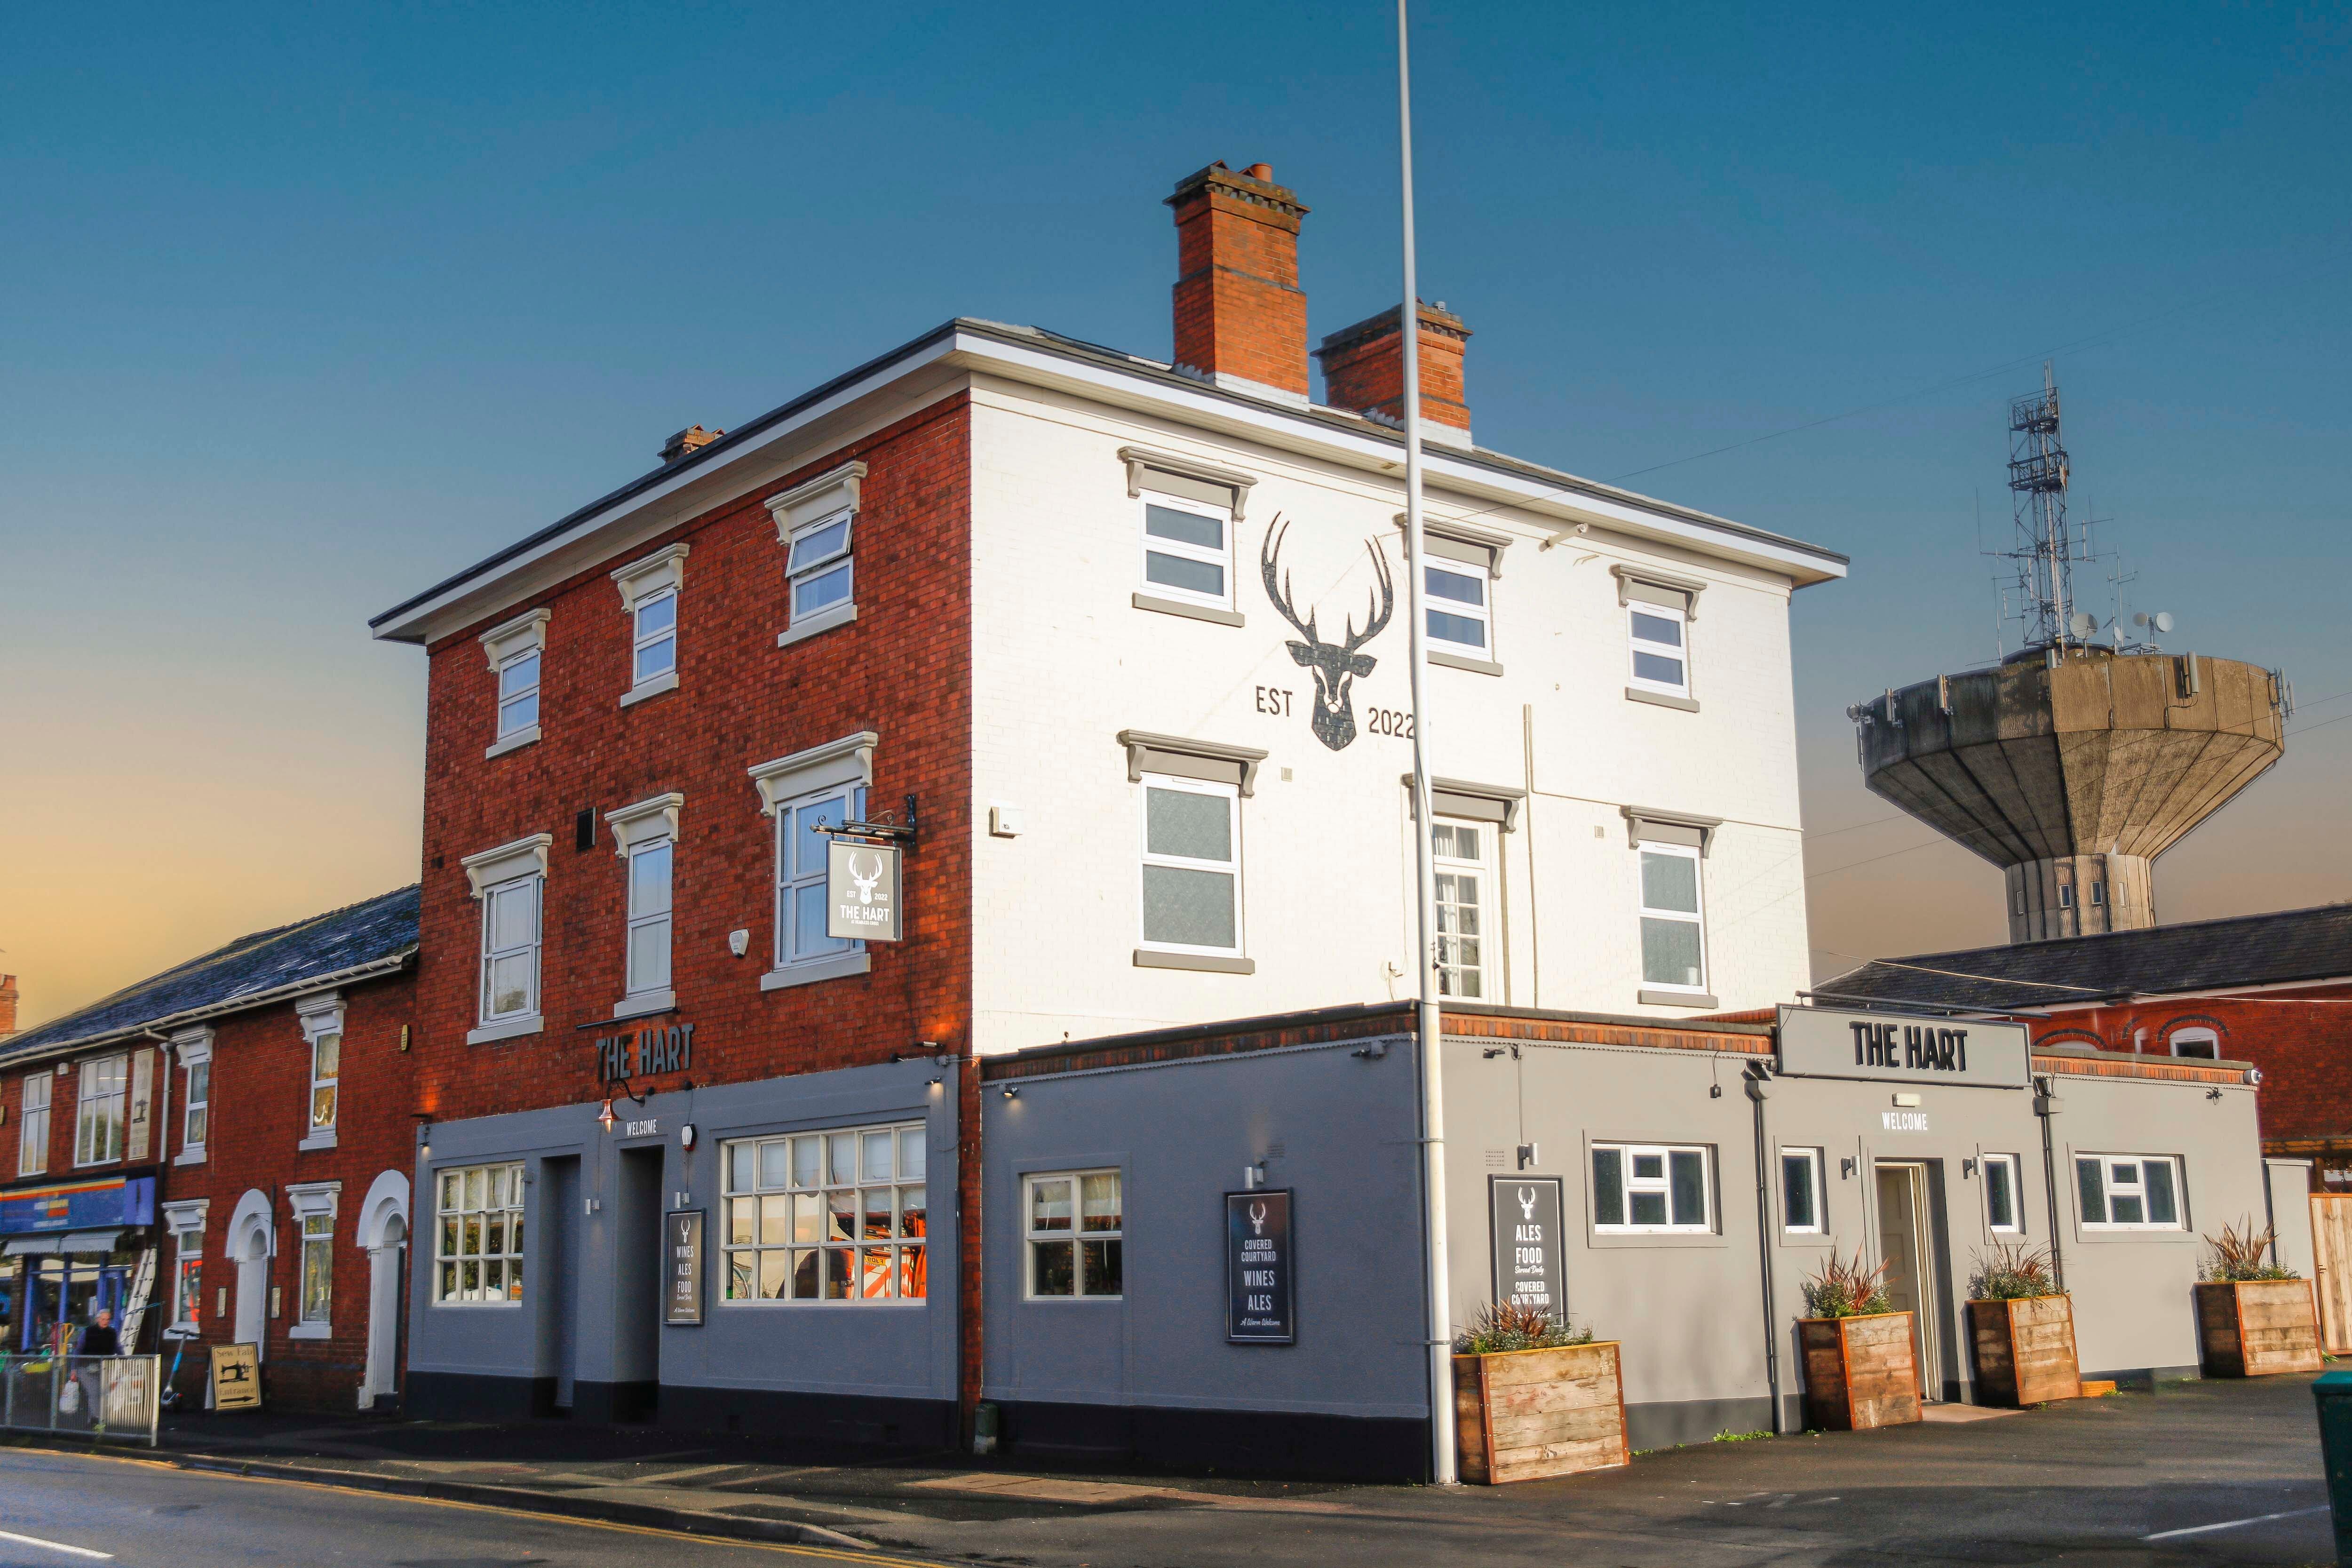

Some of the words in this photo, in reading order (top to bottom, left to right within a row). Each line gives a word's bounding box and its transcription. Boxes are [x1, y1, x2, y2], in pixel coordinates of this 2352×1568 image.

[1255, 685, 1293, 717] EST
[1368, 707, 1415, 740] 2022
[874, 892, 888, 901] 2022
[840, 904, 860, 919] THE
[863, 906, 890, 922] HART
[596, 1035, 631, 1081] THE
[639, 1023, 694, 1075] HART
[1849, 1021, 1900, 1067] THE
[1904, 1025, 1968, 1072] HART
[627, 1119, 657, 1136] WELCOME
[1882, 1112, 1928, 1130] WELCOME
[1515, 1224, 1542, 1242] ALES
[676, 1245, 694, 1258] WINES
[1245, 1239, 1272, 1250] COVERED
[1241, 1251, 1276, 1262] COURTYARD
[1516, 1247, 1542, 1264] FOOD
[678, 1263, 692, 1275] ALES
[1514, 1265, 1531, 1274] Served
[1531, 1265, 1544, 1276] Daily
[1244, 1270, 1275, 1286] WINES
[677, 1281, 692, 1293] FOOD
[1515, 1281, 1545, 1292] COVERED
[1248, 1295, 1271, 1310] ALES
[1240, 1317, 1247, 1326] A
[1261, 1318, 1280, 1326] Welcome
